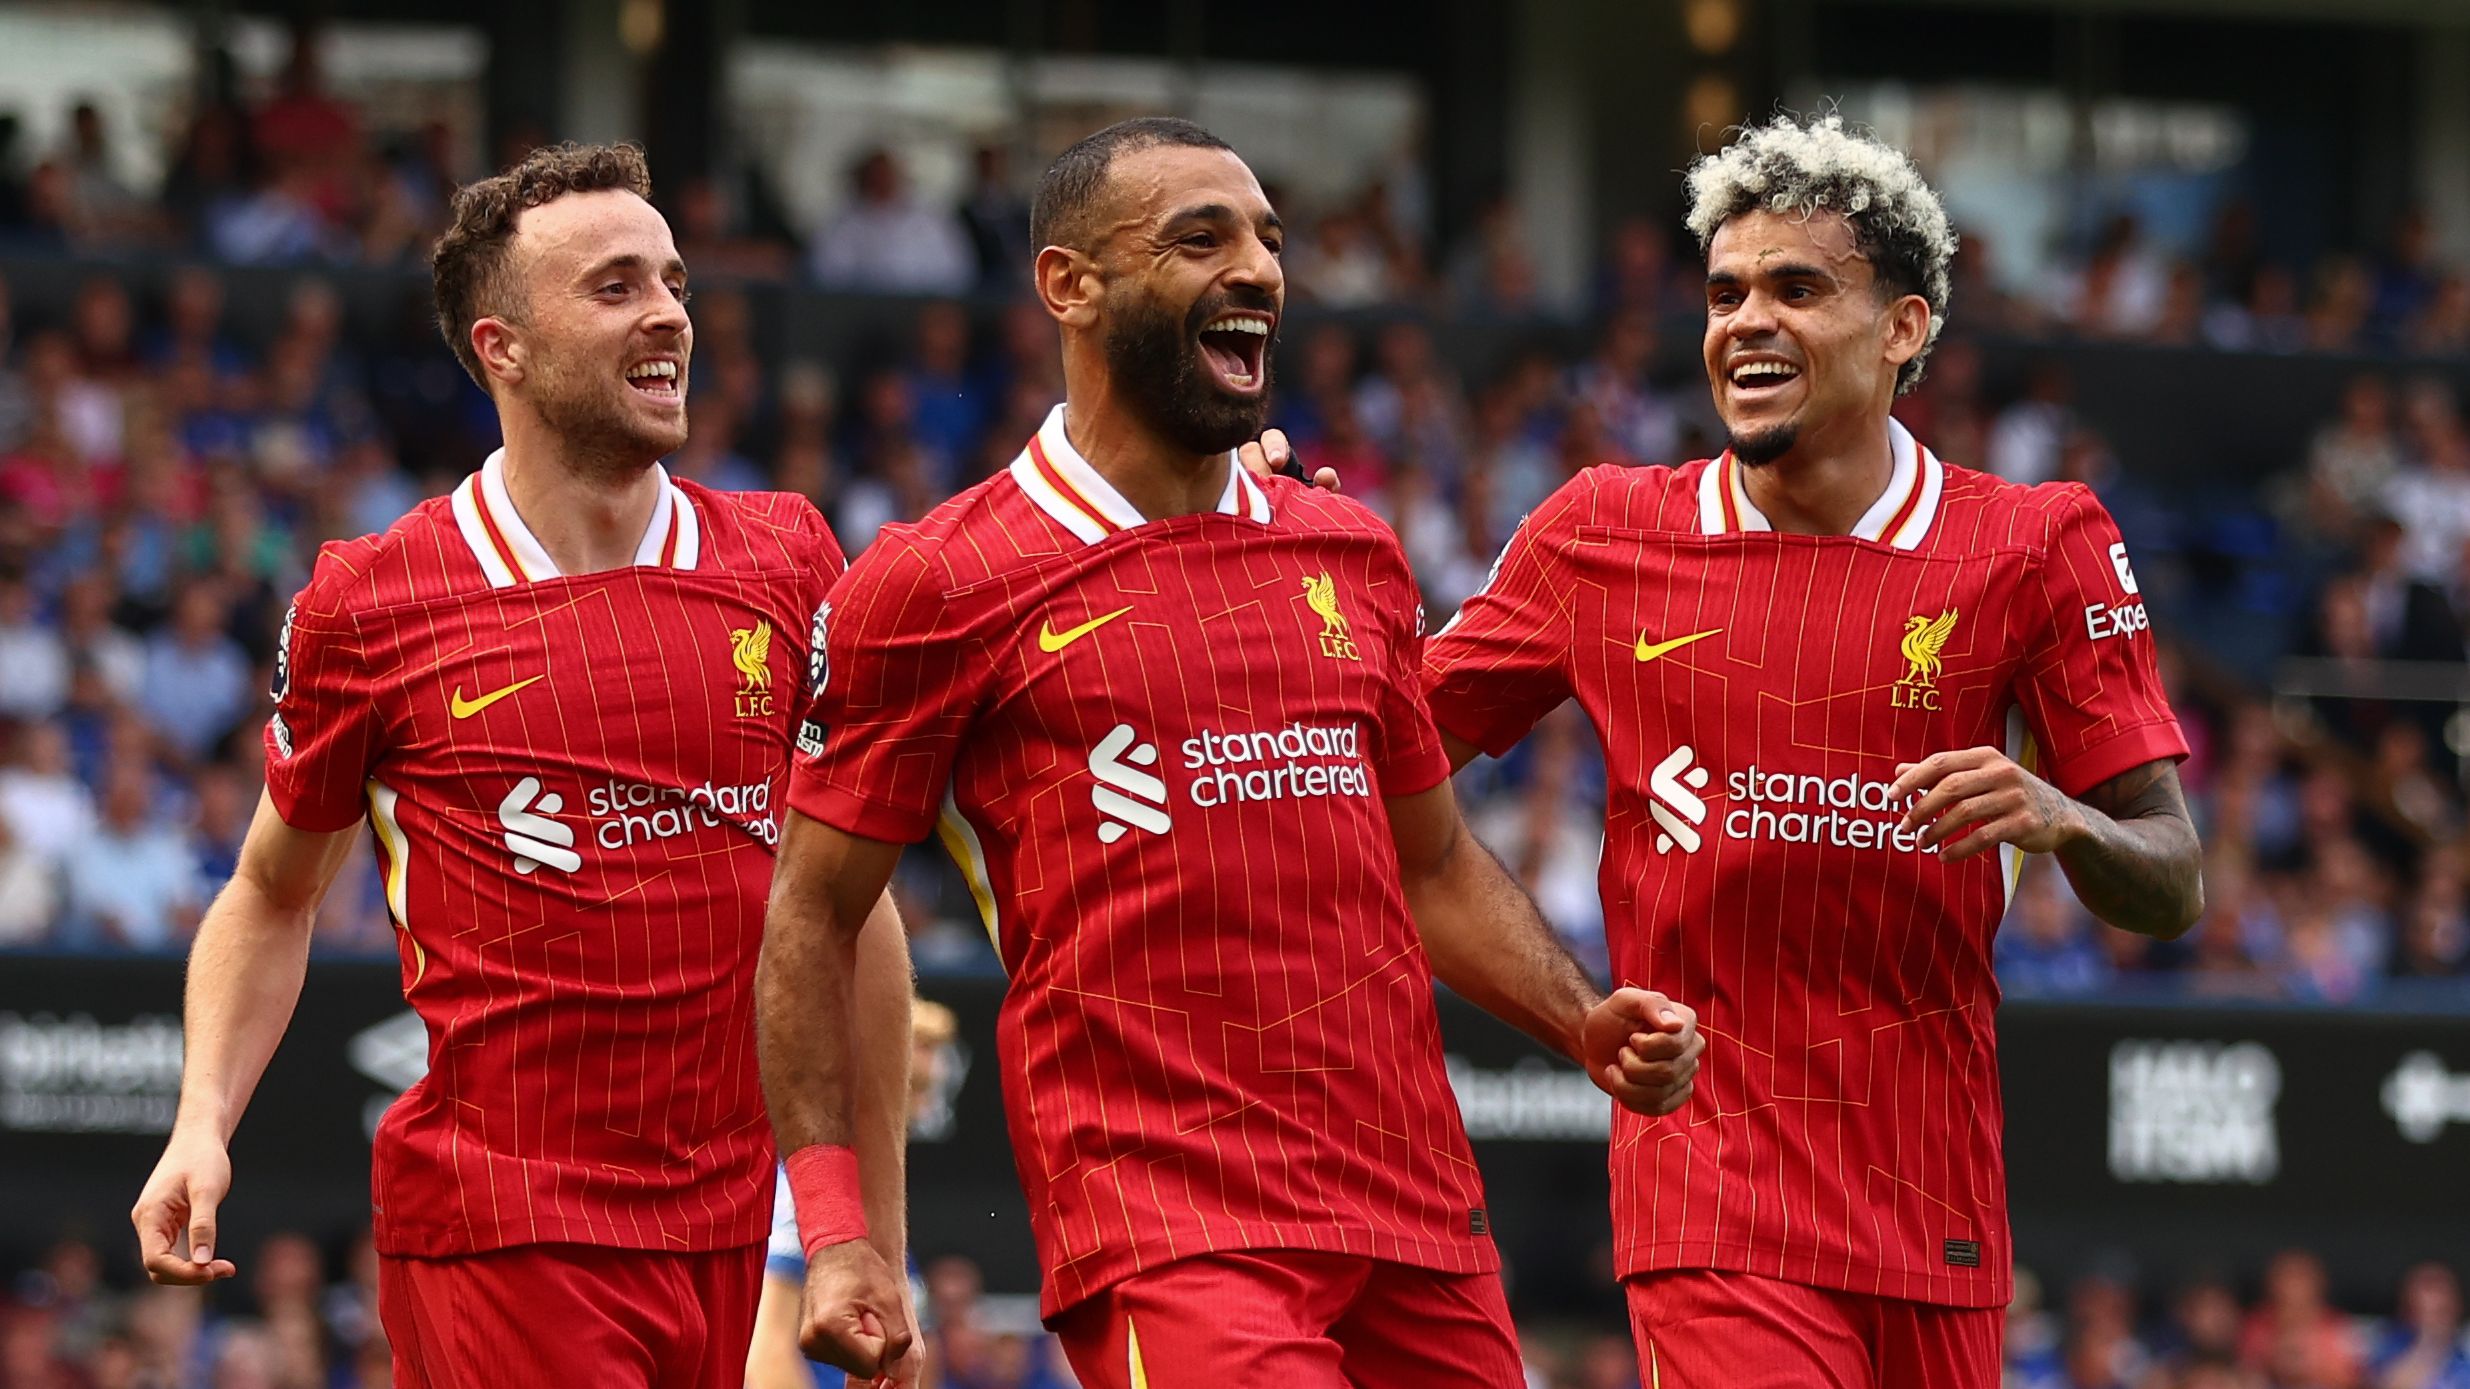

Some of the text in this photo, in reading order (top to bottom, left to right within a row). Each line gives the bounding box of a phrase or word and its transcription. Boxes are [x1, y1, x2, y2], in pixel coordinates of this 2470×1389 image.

[2085, 603, 2148, 640] Expe
[734, 695, 775, 717] L.F.C.
[1890, 686, 1942, 711] L.F.C.
[1182, 721, 1357, 769] standard
[1190, 760, 1370, 807] chartered
